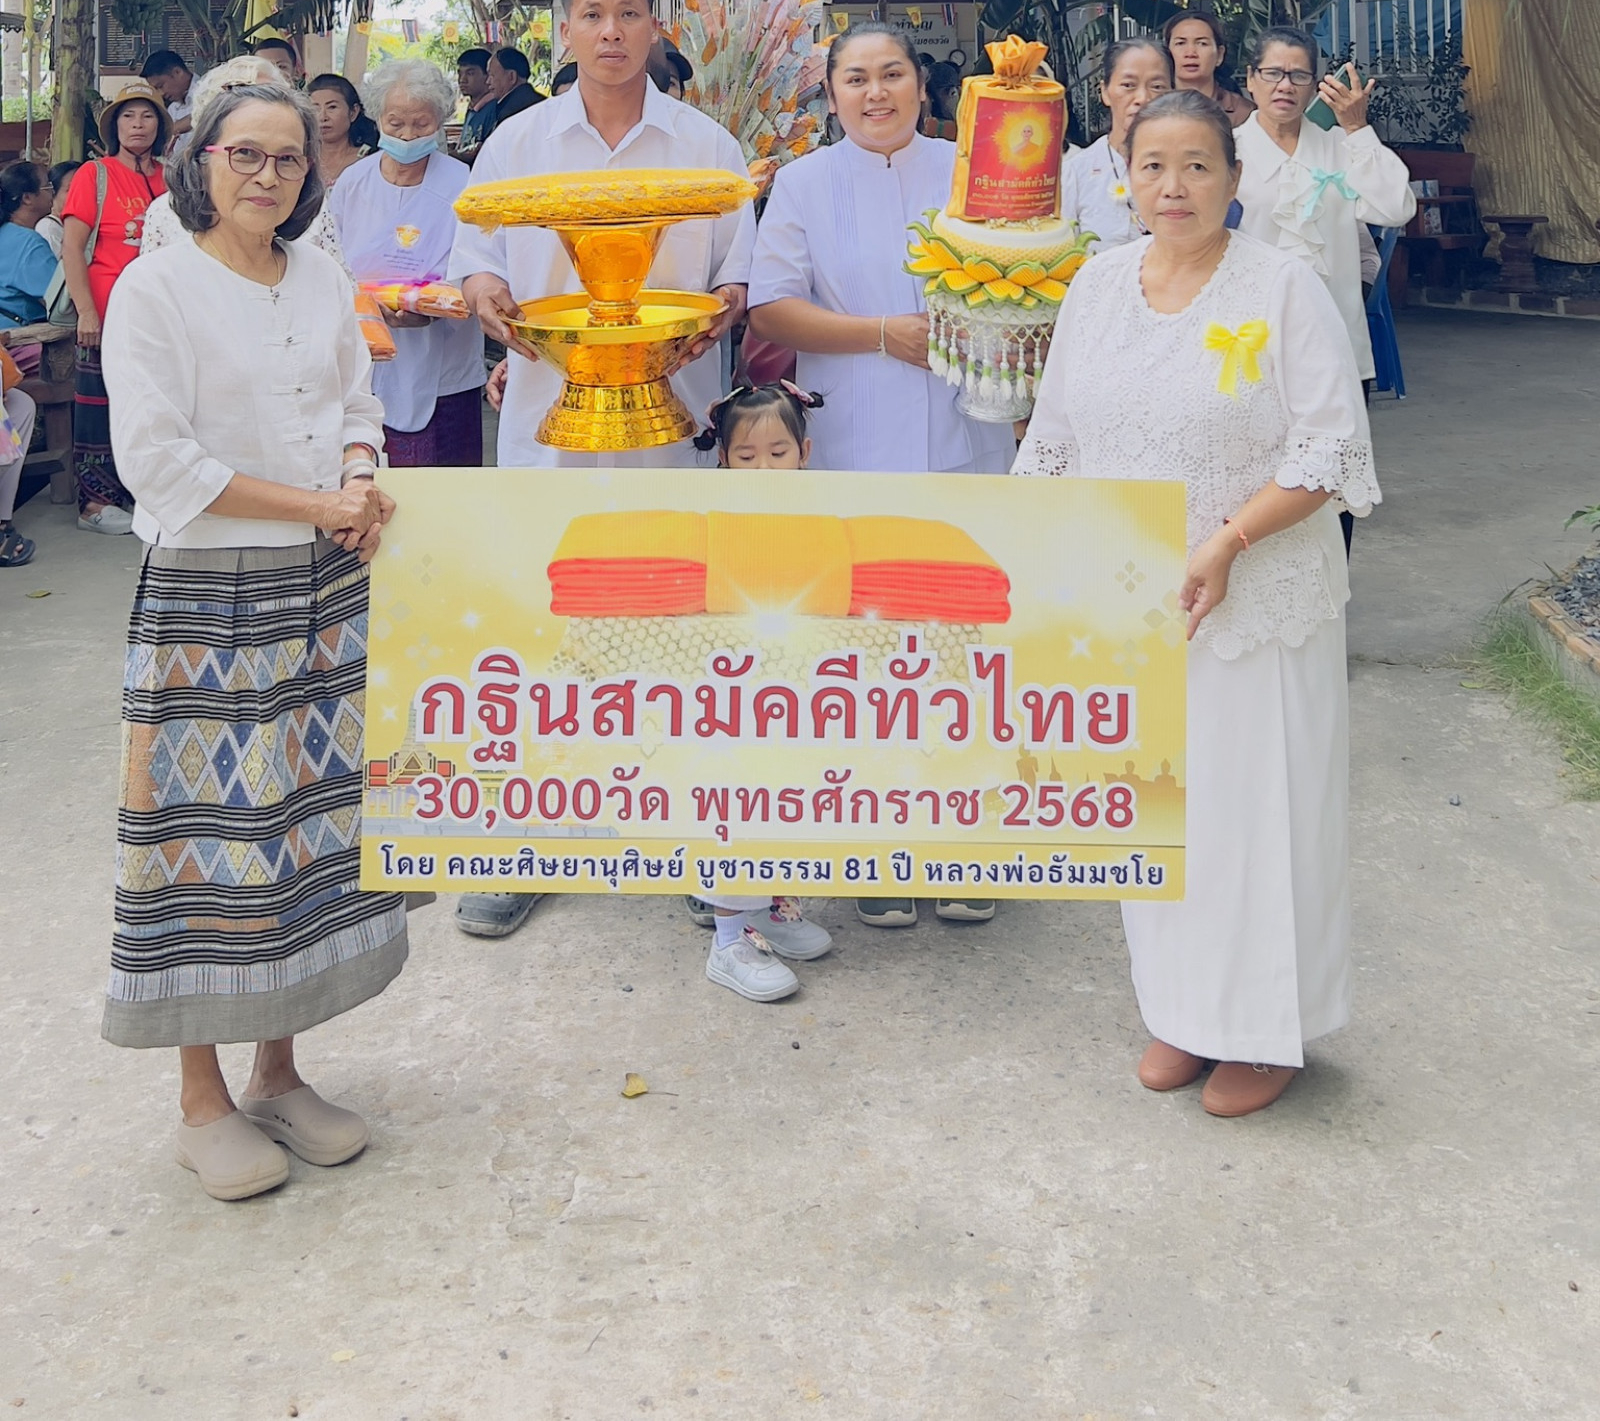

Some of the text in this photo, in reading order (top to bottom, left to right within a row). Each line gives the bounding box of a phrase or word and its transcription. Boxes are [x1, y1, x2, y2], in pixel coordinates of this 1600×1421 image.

[421, 635, 1129, 762] กฐินสามัคคีทั่วไทย
[692, 769, 980, 842] พุทธศักราช
[1003, 784, 1134, 828] 2568
[381, 845, 1164, 888] โดย คณะศิษยานุศิษย์ บูชาธรรม 81 ปี หลวงพ่อธัมมชโย
